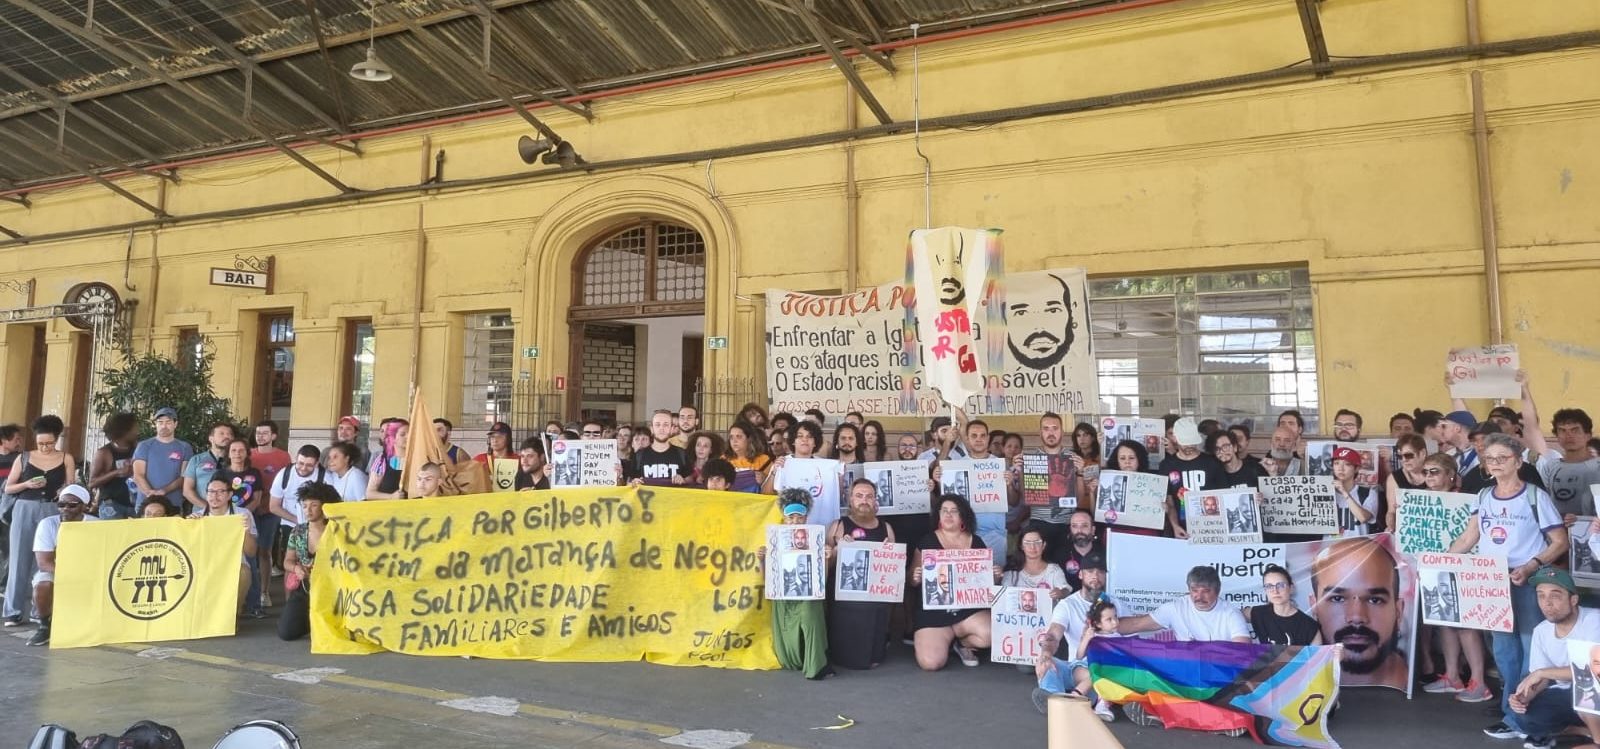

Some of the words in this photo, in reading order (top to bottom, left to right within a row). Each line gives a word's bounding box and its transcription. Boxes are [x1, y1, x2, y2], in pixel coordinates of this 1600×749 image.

[224, 272, 255, 285] BAR
[781, 287, 880, 317] JUSTIÇA
[773, 325, 855, 347] Enfrentar
[776, 357, 785, 369] e
[790, 356, 809, 370] os
[814, 350, 879, 376] ataques
[776, 372, 788, 391] O
[793, 371, 843, 391] Estado
[849, 371, 903, 391] racista
[912, 370, 921, 389] é
[825, 399, 882, 414] CLASSE
[643, 463, 679, 479] MRT
[973, 461, 1000, 470] NOSSO
[1182, 470, 1206, 491] UP
[974, 493, 1000, 503] LUTA
[1403, 492, 1442, 506] SHEILA
[1400, 505, 1450, 520] SHAYANE
[1402, 516, 1449, 531] SPENCER
[1399, 526, 1442, 541] CAMILLE
[630, 538, 662, 569] de
[1243, 547, 1280, 562] por
[1422, 554, 1462, 565] CONTRA
[1471, 558, 1497, 567] TODA
[873, 563, 898, 573] VIVER
[1460, 572, 1488, 580] FORMA
[1225, 592, 1268, 603] nenhu
[561, 615, 576, 637] E
[996, 612, 1045, 628] JUSTIÇA
